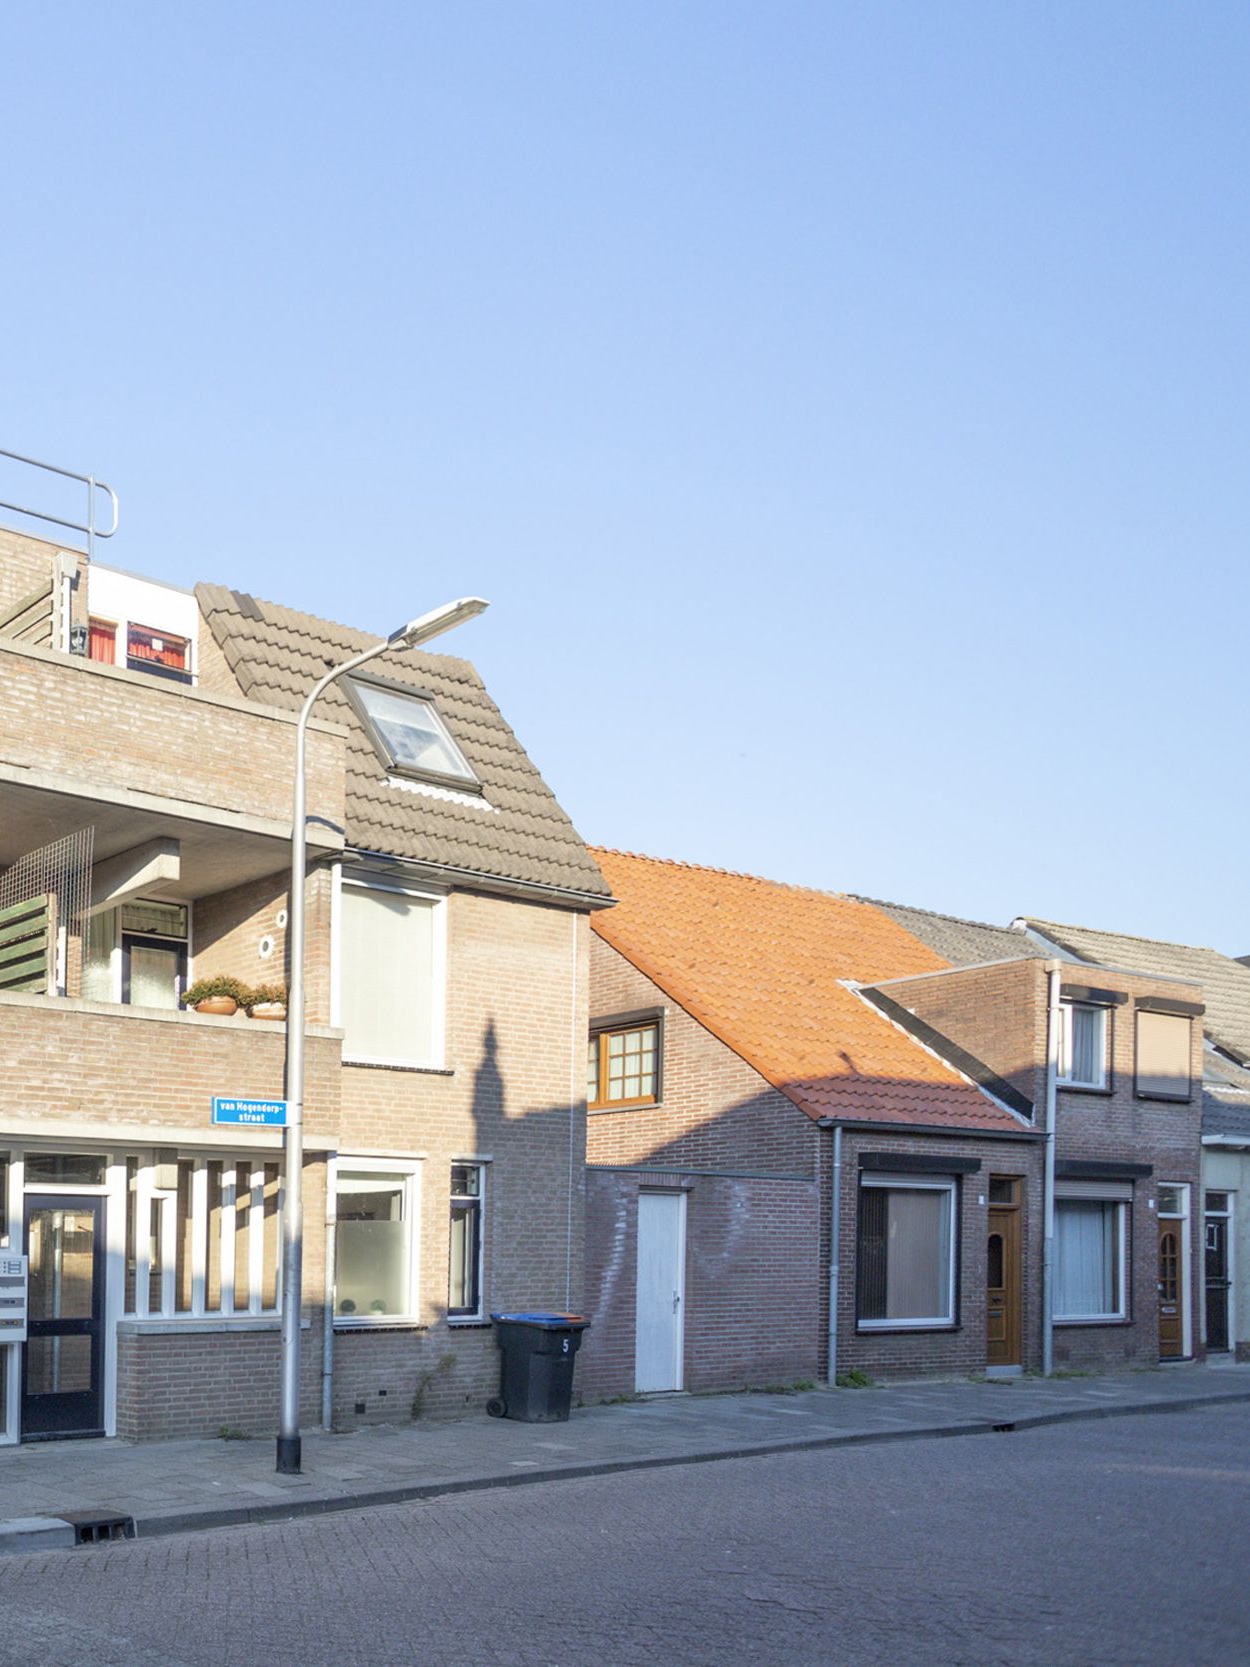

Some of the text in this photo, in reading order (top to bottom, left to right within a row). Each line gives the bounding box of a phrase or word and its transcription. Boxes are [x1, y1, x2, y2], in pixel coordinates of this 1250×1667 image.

[220, 1102, 283, 1114] van Hogendorp-
[238, 1113, 265, 1122] straat
[562, 1339, 569, 1353] 5
